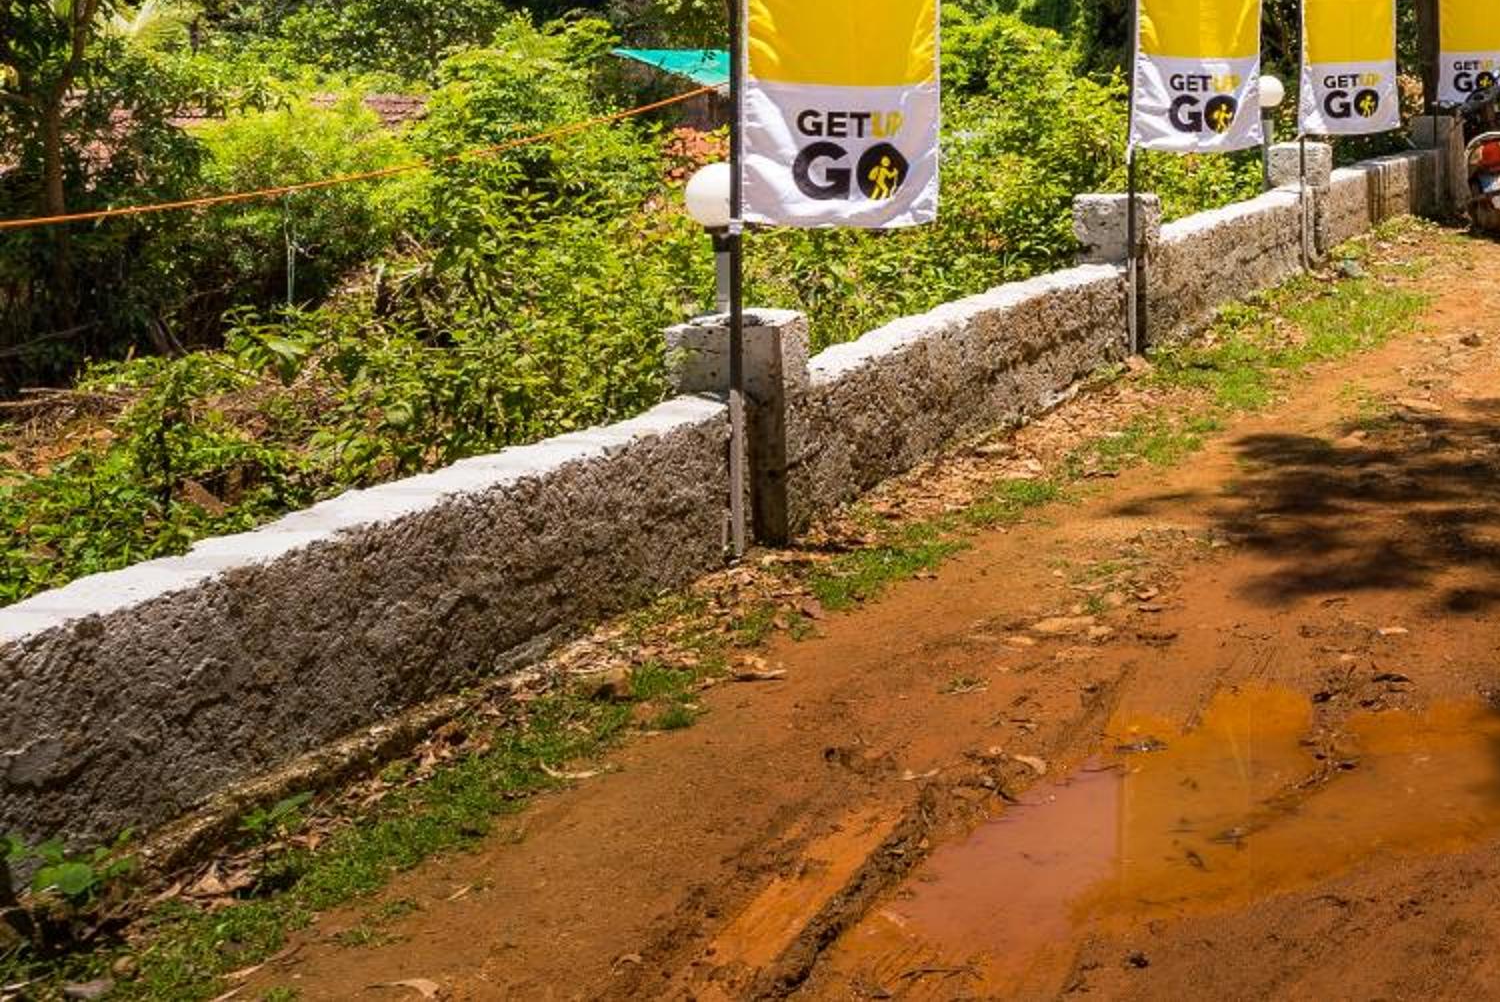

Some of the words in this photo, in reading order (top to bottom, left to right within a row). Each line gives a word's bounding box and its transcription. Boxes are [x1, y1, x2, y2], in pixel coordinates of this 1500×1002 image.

[1169, 94, 1239, 134] GO
[1323, 89, 1379, 119] GO
[793, 141, 910, 201] GO
